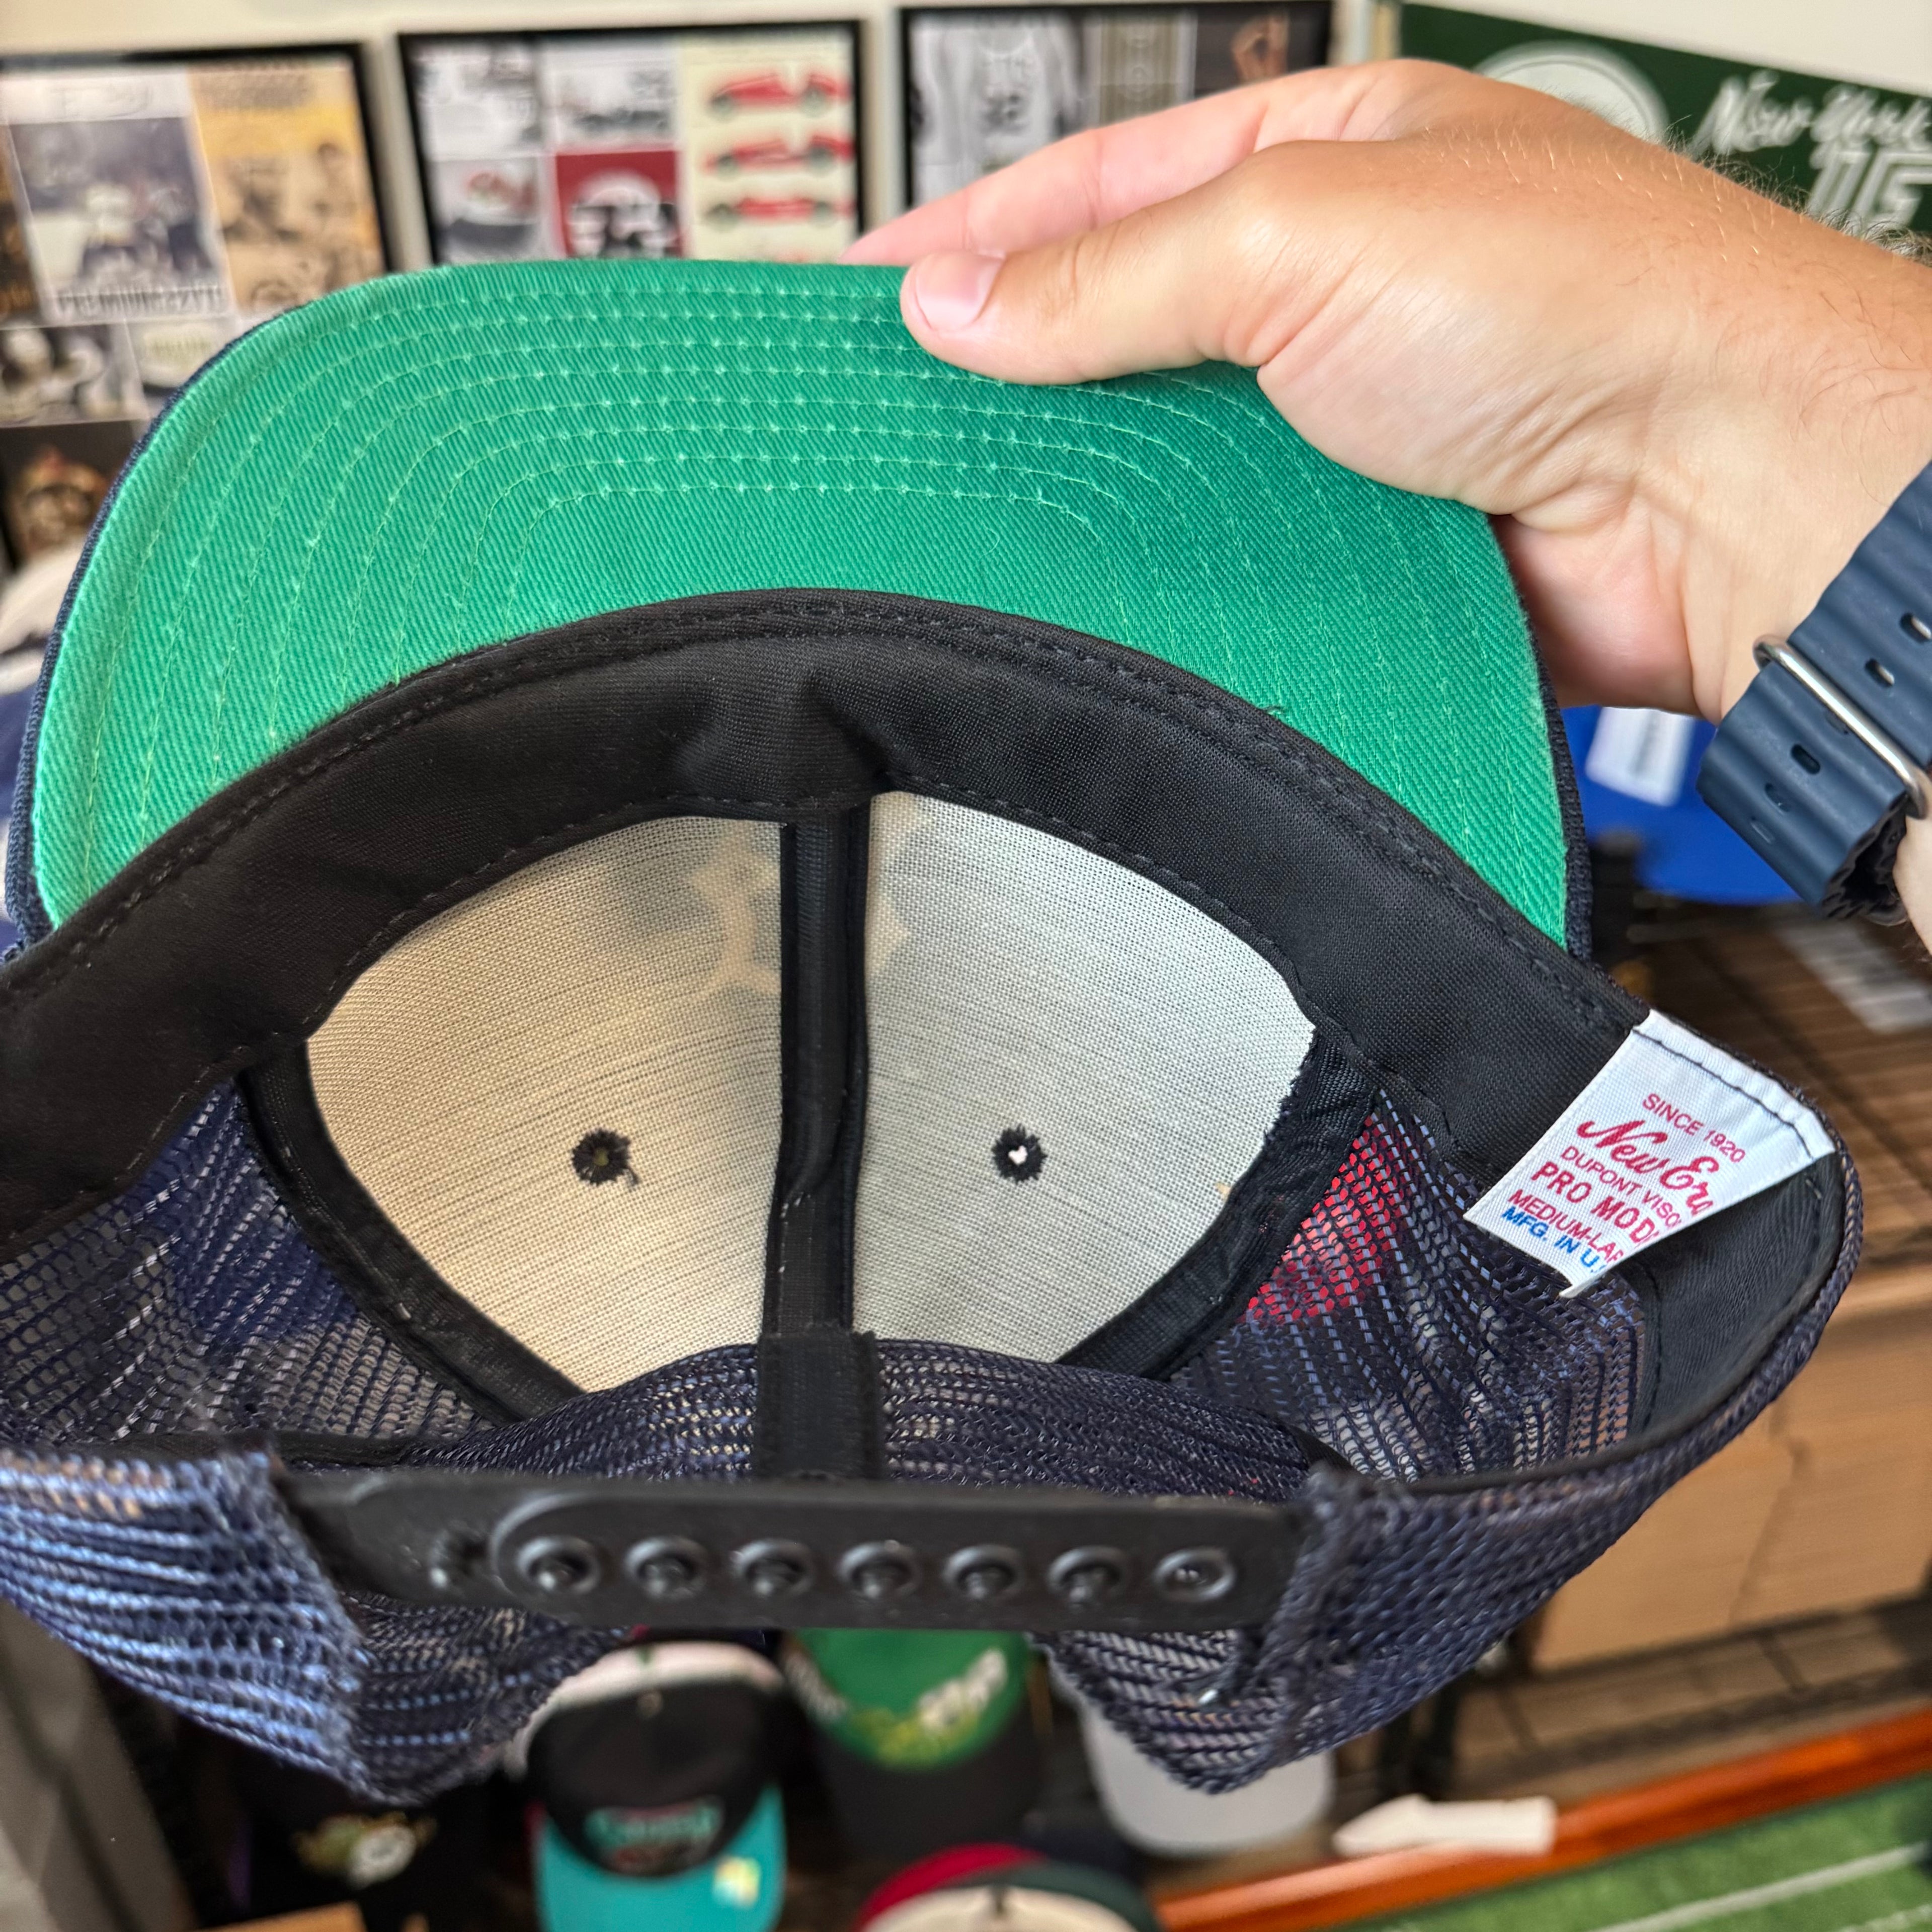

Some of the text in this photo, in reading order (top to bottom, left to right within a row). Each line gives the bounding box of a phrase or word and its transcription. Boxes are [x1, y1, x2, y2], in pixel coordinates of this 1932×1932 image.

[1576, 1120, 1670, 1174] New
[1643, 1093, 1746, 1163] SINCE 1920
[1531, 1161, 1659, 1245] PRO MOD
[1561, 1146, 1682, 1228] DUPONT VISO
[1501, 1205, 1549, 1242] MFG.
[1553, 1235, 1581, 1255] IN
